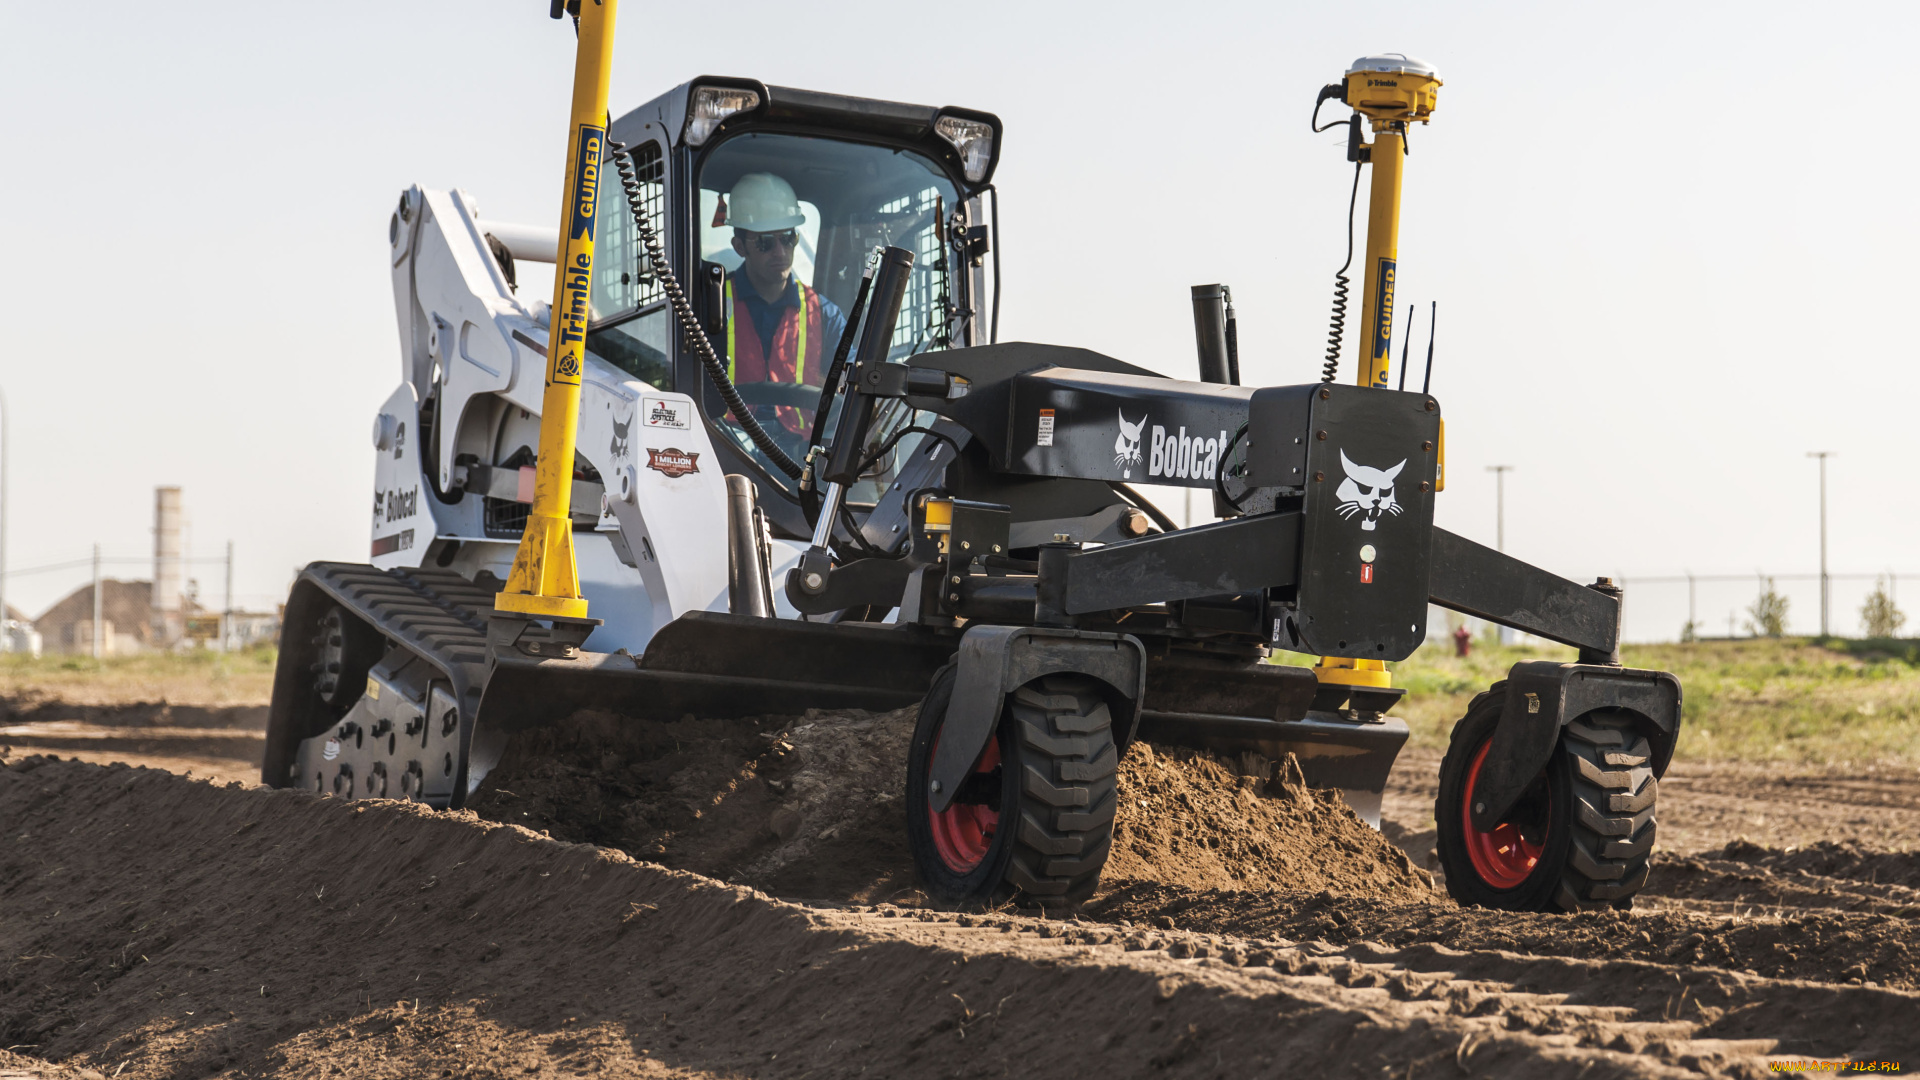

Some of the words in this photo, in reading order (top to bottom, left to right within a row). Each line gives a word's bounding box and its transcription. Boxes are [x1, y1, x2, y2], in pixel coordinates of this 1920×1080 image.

[1374, 79, 1397, 87] Trimble
[561, 253, 591, 345] Trimble
[580, 137, 600, 218] GUIDED
[1381, 269, 1395, 340] GUIDED
[660, 456, 691, 465] MILLION
[1149, 425, 1227, 481] Bobcat
[386, 484, 417, 522] Bobcat
